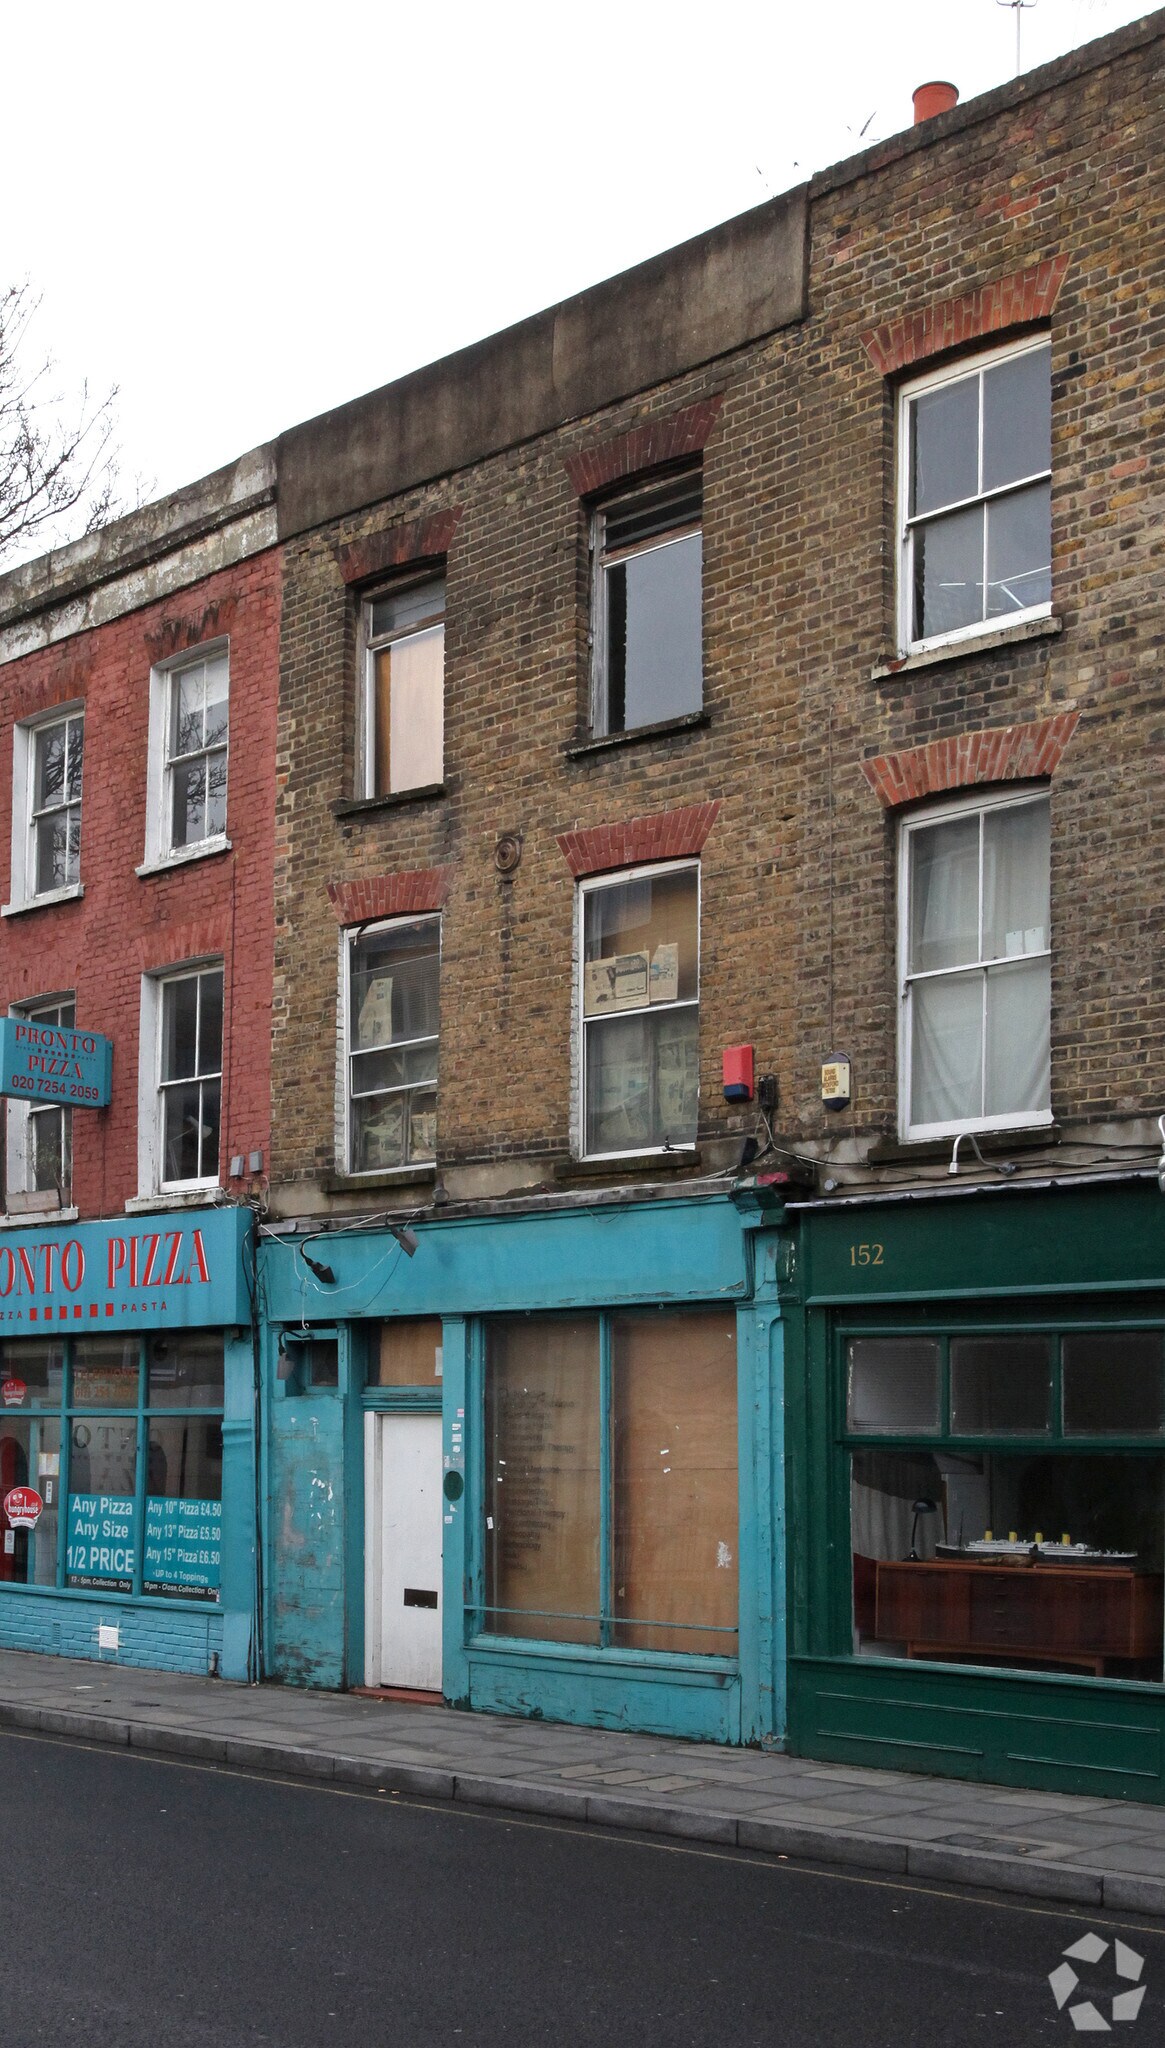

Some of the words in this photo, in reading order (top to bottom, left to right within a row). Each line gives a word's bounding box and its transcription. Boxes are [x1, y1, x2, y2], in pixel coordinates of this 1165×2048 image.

[15, 1024, 97, 1054] PRONTO
[28, 1054, 84, 1080] PIZZA
[11, 1074, 35, 1090] 020
[37, 1078, 67, 1095] 7254
[70, 1084, 99, 1100] 2059
[107, 1228, 212, 1289] PIZZA
[850, 1244, 885, 1266] 152
[121, 1301, 168, 1313] PASTA
[8, 1495, 39, 1516] hungryhouse
[72, 1496, 97, 1517] Any
[100, 1497, 133, 1516] Pizza
[147, 1500, 163, 1517] Any
[200, 1502, 222, 1517] £4.50
[74, 1519, 99, 1540] Any
[102, 1520, 129, 1538] Size
[146, 1523, 162, 1540] Any
[200, 1526, 221, 1541] £5.50
[67, 1545, 86, 1569] 1/2
[90, 1546, 135, 1573] PRICE
[146, 1546, 161, 1563] Any
[199, 1550, 220, 1565] £6.50
[92, 1578, 117, 1587] Collection
[119, 1580, 131, 1590] Only
[179, 1571, 209, 1584] Toppings
[178, 1585, 205, 1594] Collection
